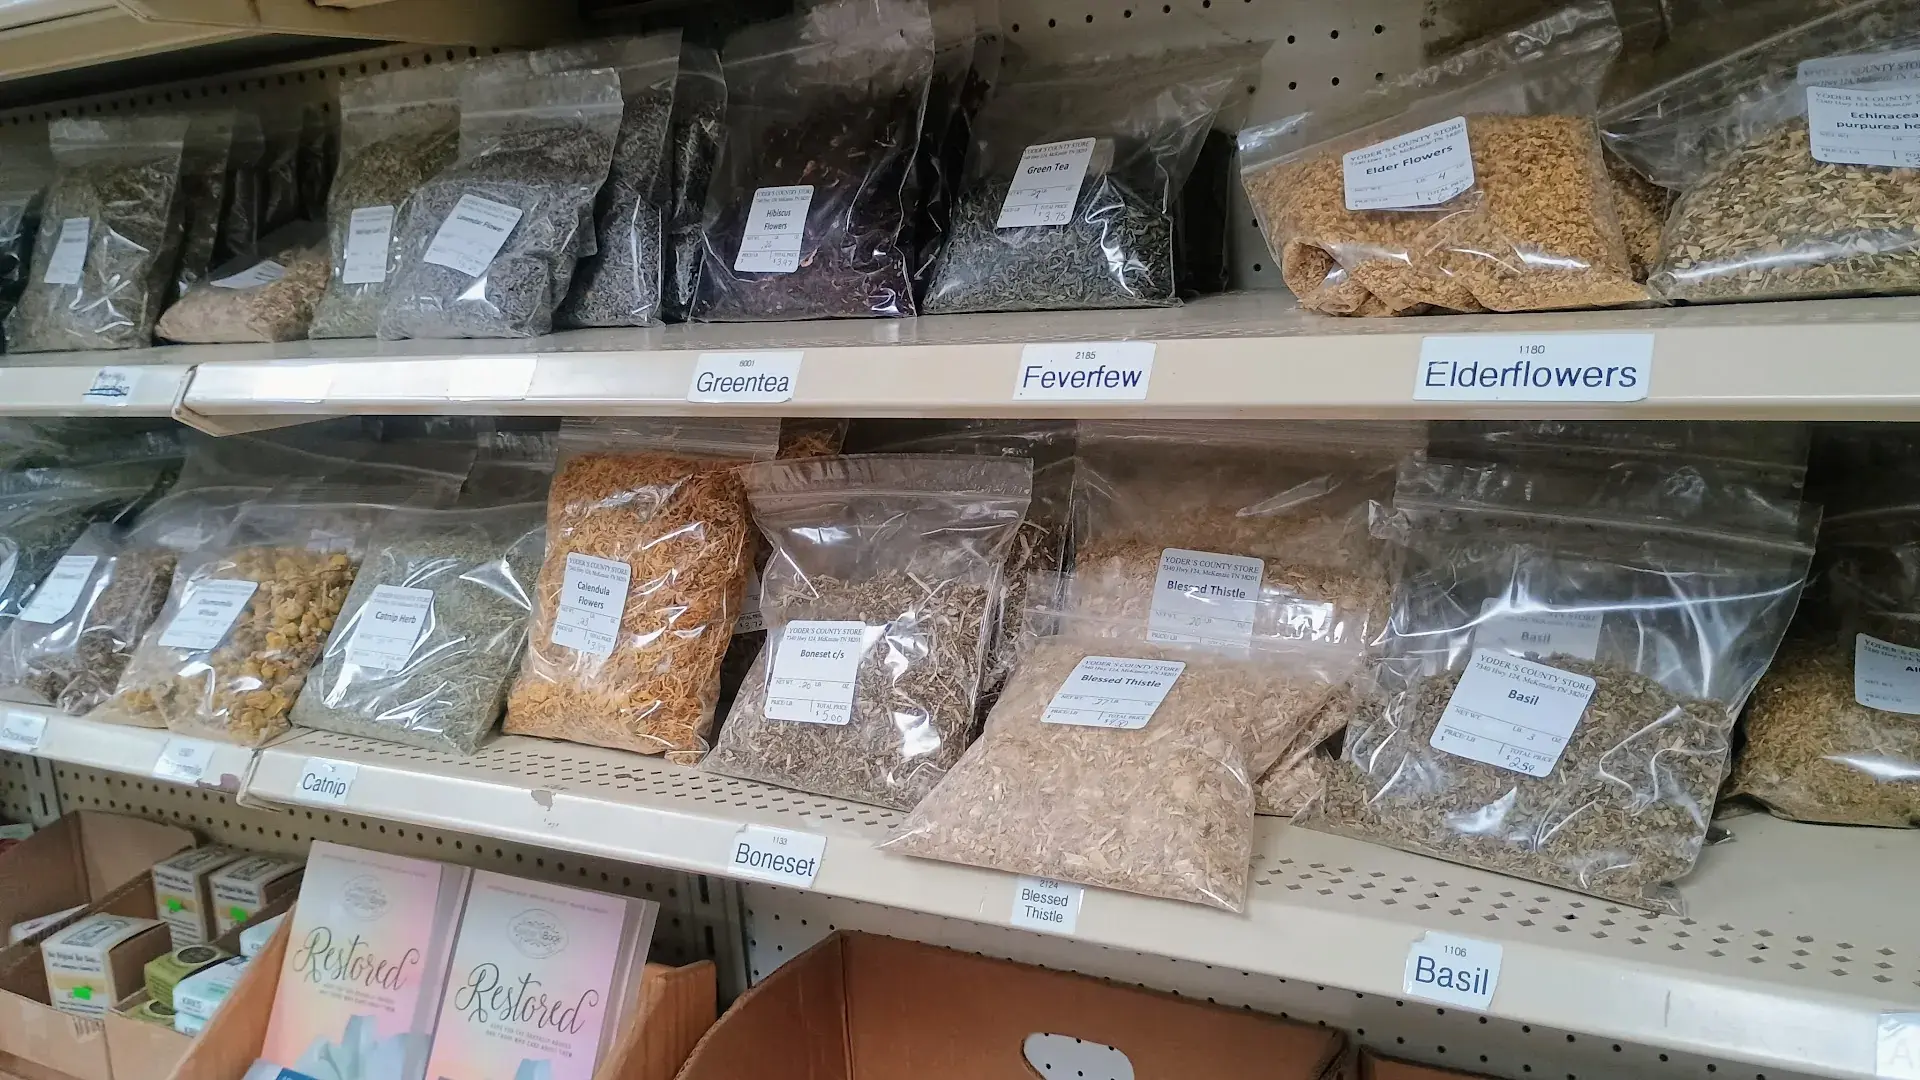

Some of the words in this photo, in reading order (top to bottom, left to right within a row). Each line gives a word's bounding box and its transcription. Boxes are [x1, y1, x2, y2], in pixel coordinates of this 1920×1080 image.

[1850, 112, 1919, 120] Echinacea
[1836, 121, 1900, 130] purpurea
[1392, 133, 1431, 151] COUNTY
[1434, 123, 1463, 137] STORE
[1366, 162, 1399, 175] Elder
[1403, 145, 1453, 167] Flowers
[1027, 165, 1052, 174] Green
[1054, 162, 1070, 171] Tea
[766, 209, 791, 217] Hibiscus
[1075, 352, 1096, 360] 2185
[1518, 345, 1545, 354] 1180
[1023, 365, 1142, 388] Feverfew
[1426, 360, 1637, 387] Elderflowers
[697, 372, 789, 392] Greentea
[590, 562, 610, 571] COUNTY
[611, 567, 628, 575] STORE
[1165, 556, 1198, 567] YODER'S
[1199, 560, 1232, 571] COUNTY
[1234, 564, 1259, 574] STORE
[578, 581, 610, 595] Calendula
[1210, 585, 1246, 598] Thistle
[578, 596, 604, 609] Flowers
[376, 611, 398, 623] Catnip
[400, 614, 417, 624] Herb
[1521, 631, 1551, 644] Basil
[800, 649, 831, 658] Boneset
[832, 650, 845, 660] c/s
[1120, 662, 1152, 670] COUNTY
[1480, 655, 1519, 672] YODER'S
[1521, 666, 1560, 684] COUNTY
[1562, 678, 1591, 692] STORE
[1081, 674, 1122, 684] Blessed
[1125, 678, 1161, 688] Thistle
[1475, 663, 1491, 673] 7340
[1492, 667, 1506, 678] Hwy
[1523, 677, 1555, 690] McKenzie
[1557, 686, 1567, 694] TN
[1568, 689, 1588, 699] 38201
[1508, 690, 1539, 706] Basil
[1455, 708, 1469, 716] NET
[1510, 748, 1531, 758] TOTAL
[1533, 754, 1552, 763] PRICE
[303, 773, 346, 798] Catnip
[773, 837, 787, 845] 1133
[735, 843, 815, 877] Boneset
[1040, 880, 1058, 889] 2124
[1022, 888, 1068, 907] Blessed
[1025, 905, 1063, 923] Thistle
[1444, 945, 1466, 957] 1106
[293, 926, 420, 991] Restored
[1416, 956, 1488, 995] Basil
[455, 963, 599, 1035] Restored
